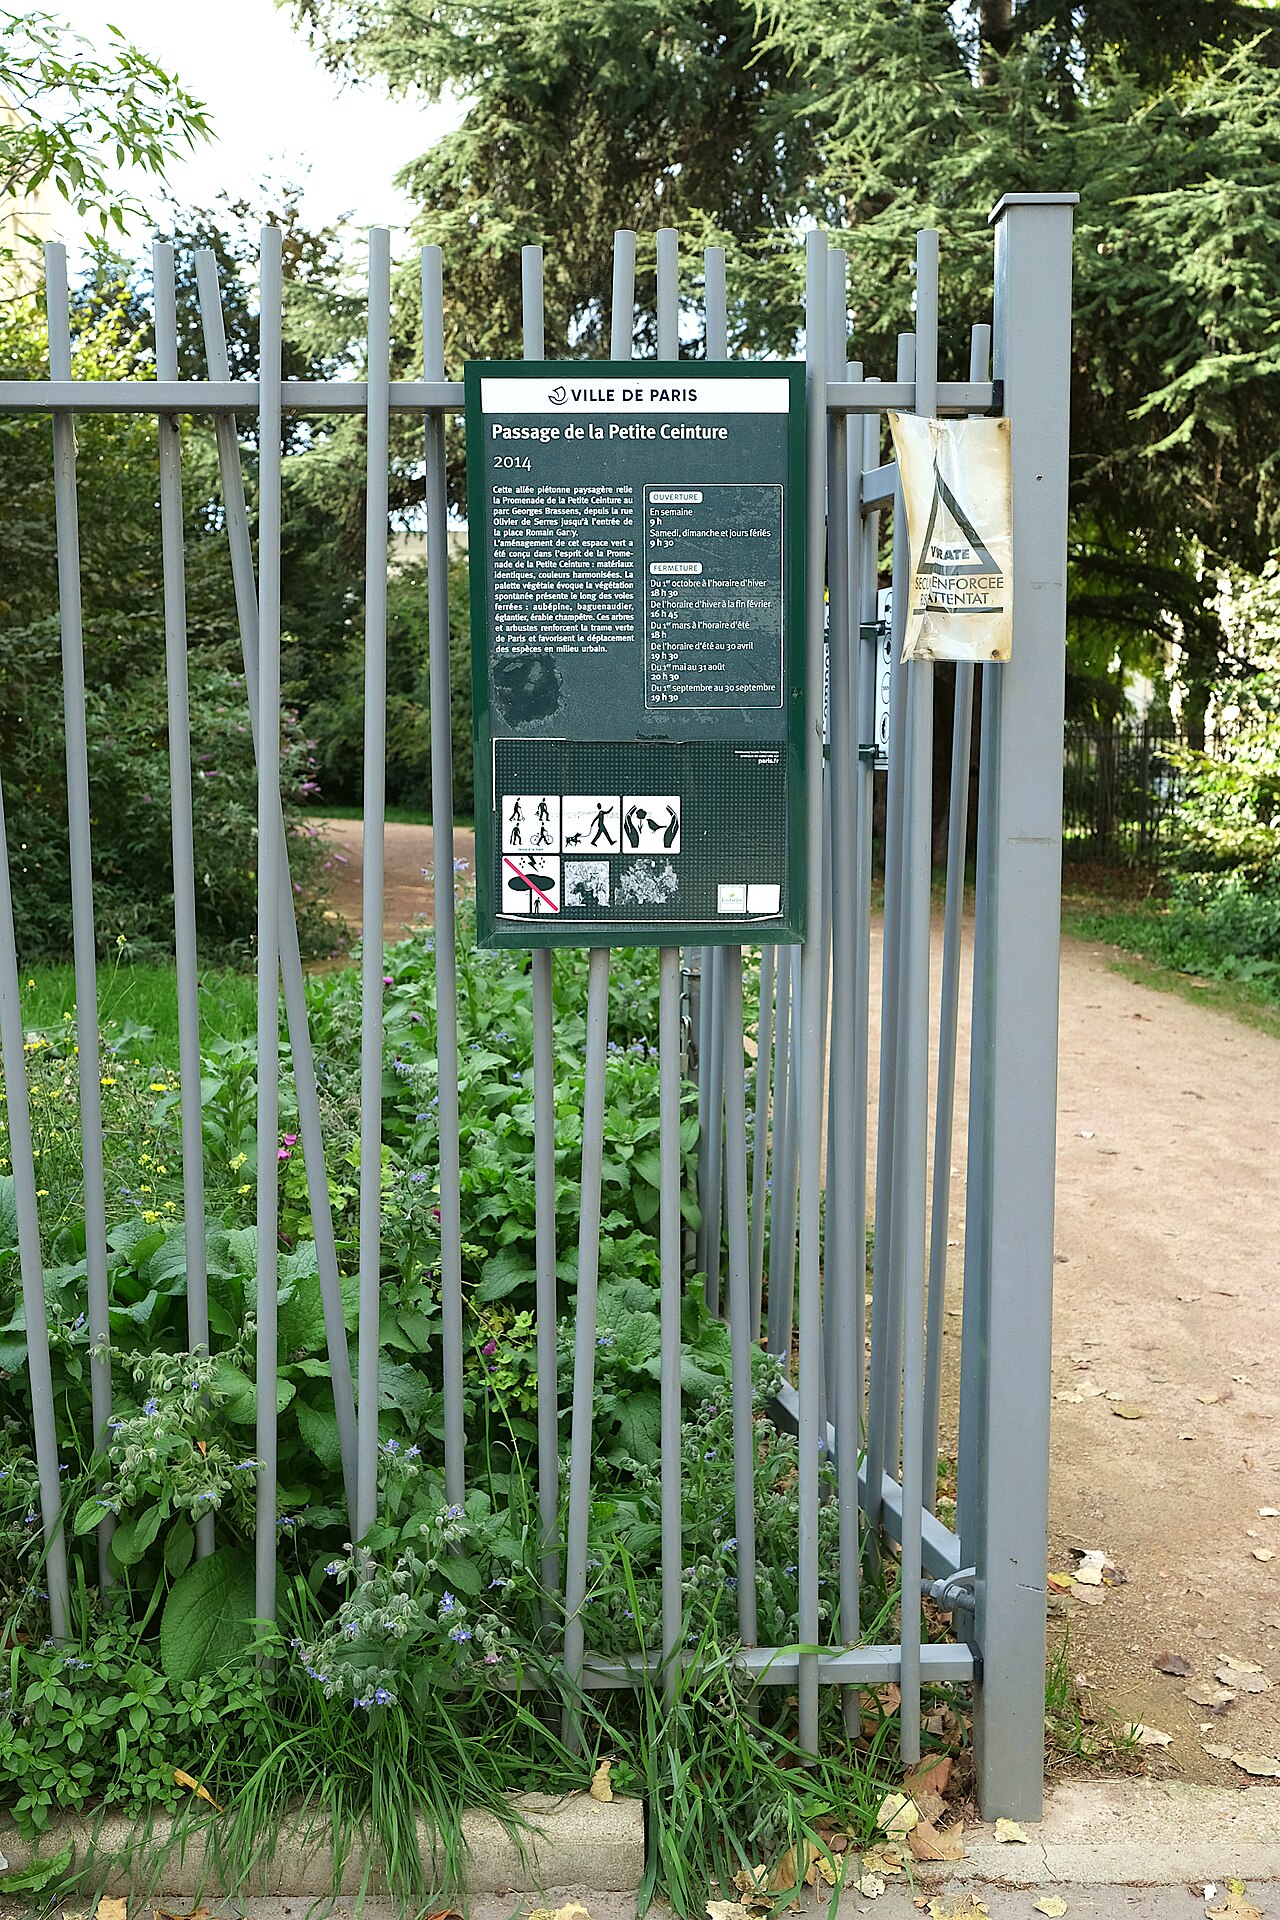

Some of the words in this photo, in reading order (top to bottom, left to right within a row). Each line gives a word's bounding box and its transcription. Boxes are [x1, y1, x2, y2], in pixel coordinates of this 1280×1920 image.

[571, 389, 615, 402] VILLE
[622, 389, 643, 402] DE
[650, 389, 698, 402] PARIS
[492, 424, 560, 443] Passage
[564, 424, 584, 439] de
[589, 424, 604, 439] la
[609, 424, 656, 439] Petite
[660, 424, 728, 439] Ceinture
[493, 456, 532, 471] 2014
[493, 485, 512, 494] Cette
[516, 485, 534, 494] allée
[574, 485, 613, 496] paysagère
[493, 496, 500, 505] la
[503, 495, 544, 505] Promenade
[547, 495, 556, 505] de
[559, 495, 565, 505] la
[568, 495, 589, 505] Petite
[591, 495, 621, 505] Ceinture
[653, 493, 698, 501] OUVERTURE
[494, 508, 509, 517] parc
[512, 506, 543, 517] Georges
[584, 506, 609, 517] depuis
[612, 506, 618, 515] la
[649, 507, 660, 516] En
[660, 507, 693, 516] semaine
[521, 517, 531, 526] de
[534, 517, 558, 526] Serres
[623, 517, 633, 526] de
[494, 528, 500, 537] la
[504, 528, 523, 538] place
[526, 528, 553, 537] Romain
[682, 528, 720, 537] dimanche
[720, 529, 729, 538] et
[729, 528, 749, 539] jours
[556, 538, 565, 547] de
[568, 539, 579, 547] cet
[582, 540, 608, 549] espace
[611, 539, 626, 547] vert
[663, 540, 674, 549] 30
[494, 549, 505, 558] été
[534, 549, 552, 558] dans
[584, 548, 593, 558] de
[597, 549, 603, 558] la
[494, 560, 513, 569] nade
[515, 559, 524, 569] de
[527, 560, 534, 568] la
[536, 559, 557, 569] Petite
[559, 559, 590, 568] Ceinture
[653, 564, 698, 572] FERMETURE
[539, 570, 570, 579] couleurs
[625, 570, 633, 579] La
[650, 579, 662, 588] Du
[671, 578, 701, 588] octobre
[536, 591, 568, 602] présente
[571, 591, 577, 600] le
[580, 591, 596, 602] long
[599, 591, 612, 600] des
[650, 588, 660, 597] 18
[668, 590, 679, 599] 30
[650, 600, 662, 609] De
[727, 599, 735, 608] la
[650, 609, 660, 618] 16
[668, 611, 679, 620] 45
[650, 621, 662, 630] Du
[672, 622, 691, 630] mars
[496, 634, 505, 643] de
[508, 634, 526, 643] Paris
[529, 634, 536, 643] et
[539, 633, 575, 643] favorisent
[578, 633, 584, 642] le
[587, 633, 634, 644] déplacement
[650, 630, 660, 639] 18
[495, 644, 509, 653] des
[512, 644, 542, 655] espèces
[557, 644, 578, 653] milieu
[650, 642, 662, 651] De
[726, 643, 737, 652] 30
[737, 641, 754, 650] avril
[650, 653, 660, 662] 19
[668, 652, 679, 661] 30
[650, 663, 662, 672] Du
[672, 662, 687, 671] mai
[698, 664, 708, 673] 31
[708, 662, 726, 671] août
[650, 673, 661, 681] 20
[669, 673, 680, 682] 30
[651, 683, 662, 692] Du
[672, 683, 713, 694] septembre
[724, 684, 735, 693] 30
[735, 682, 776, 693] septembre
[650, 694, 660, 703] 19
[668, 694, 679, 703] 30
